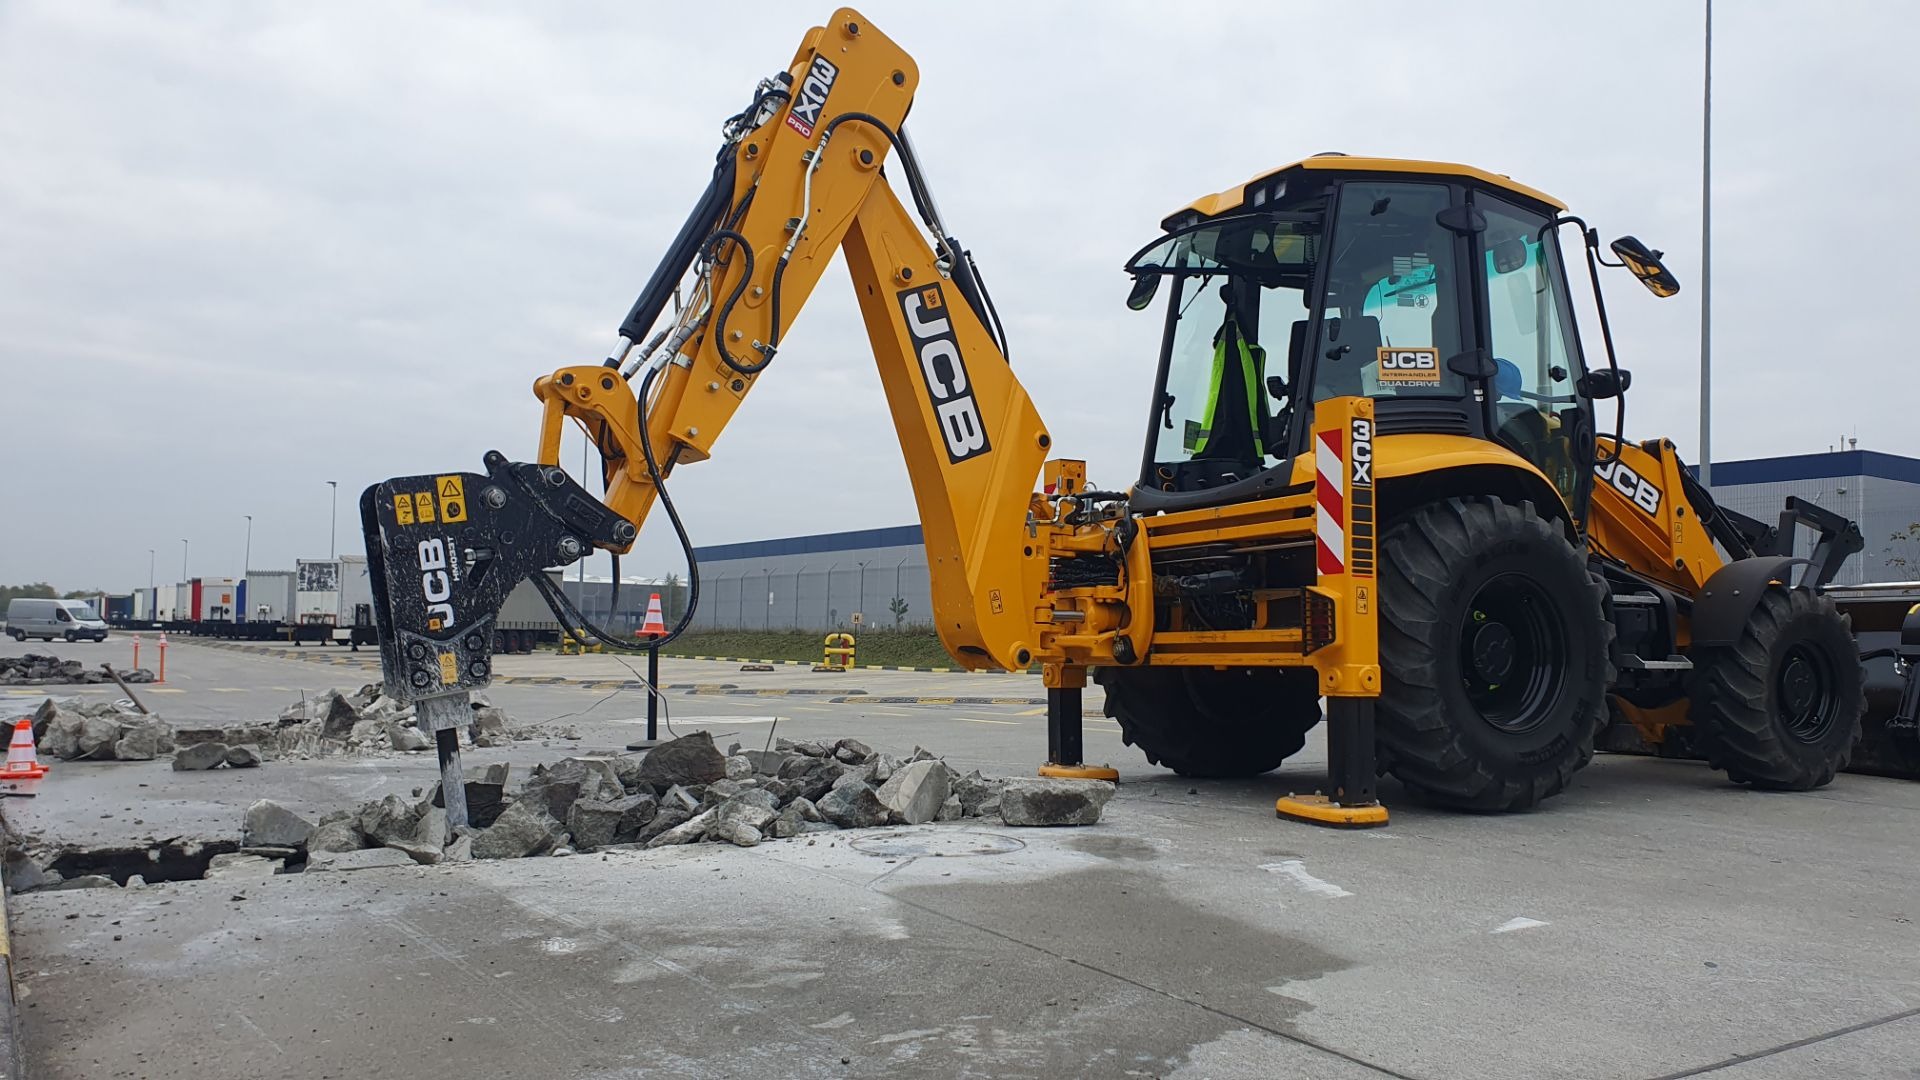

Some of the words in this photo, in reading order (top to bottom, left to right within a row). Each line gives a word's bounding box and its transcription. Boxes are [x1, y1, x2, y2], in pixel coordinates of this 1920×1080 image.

[794, 57, 836, 123] 3CX
[787, 116, 811, 137] PRO
[904, 292, 985, 457] JCB
[1382, 352, 1434, 369] JCB
[1352, 420, 1371, 482] 3CX
[1594, 461, 1660, 514] JCB
[418, 538, 455, 628] JCB
